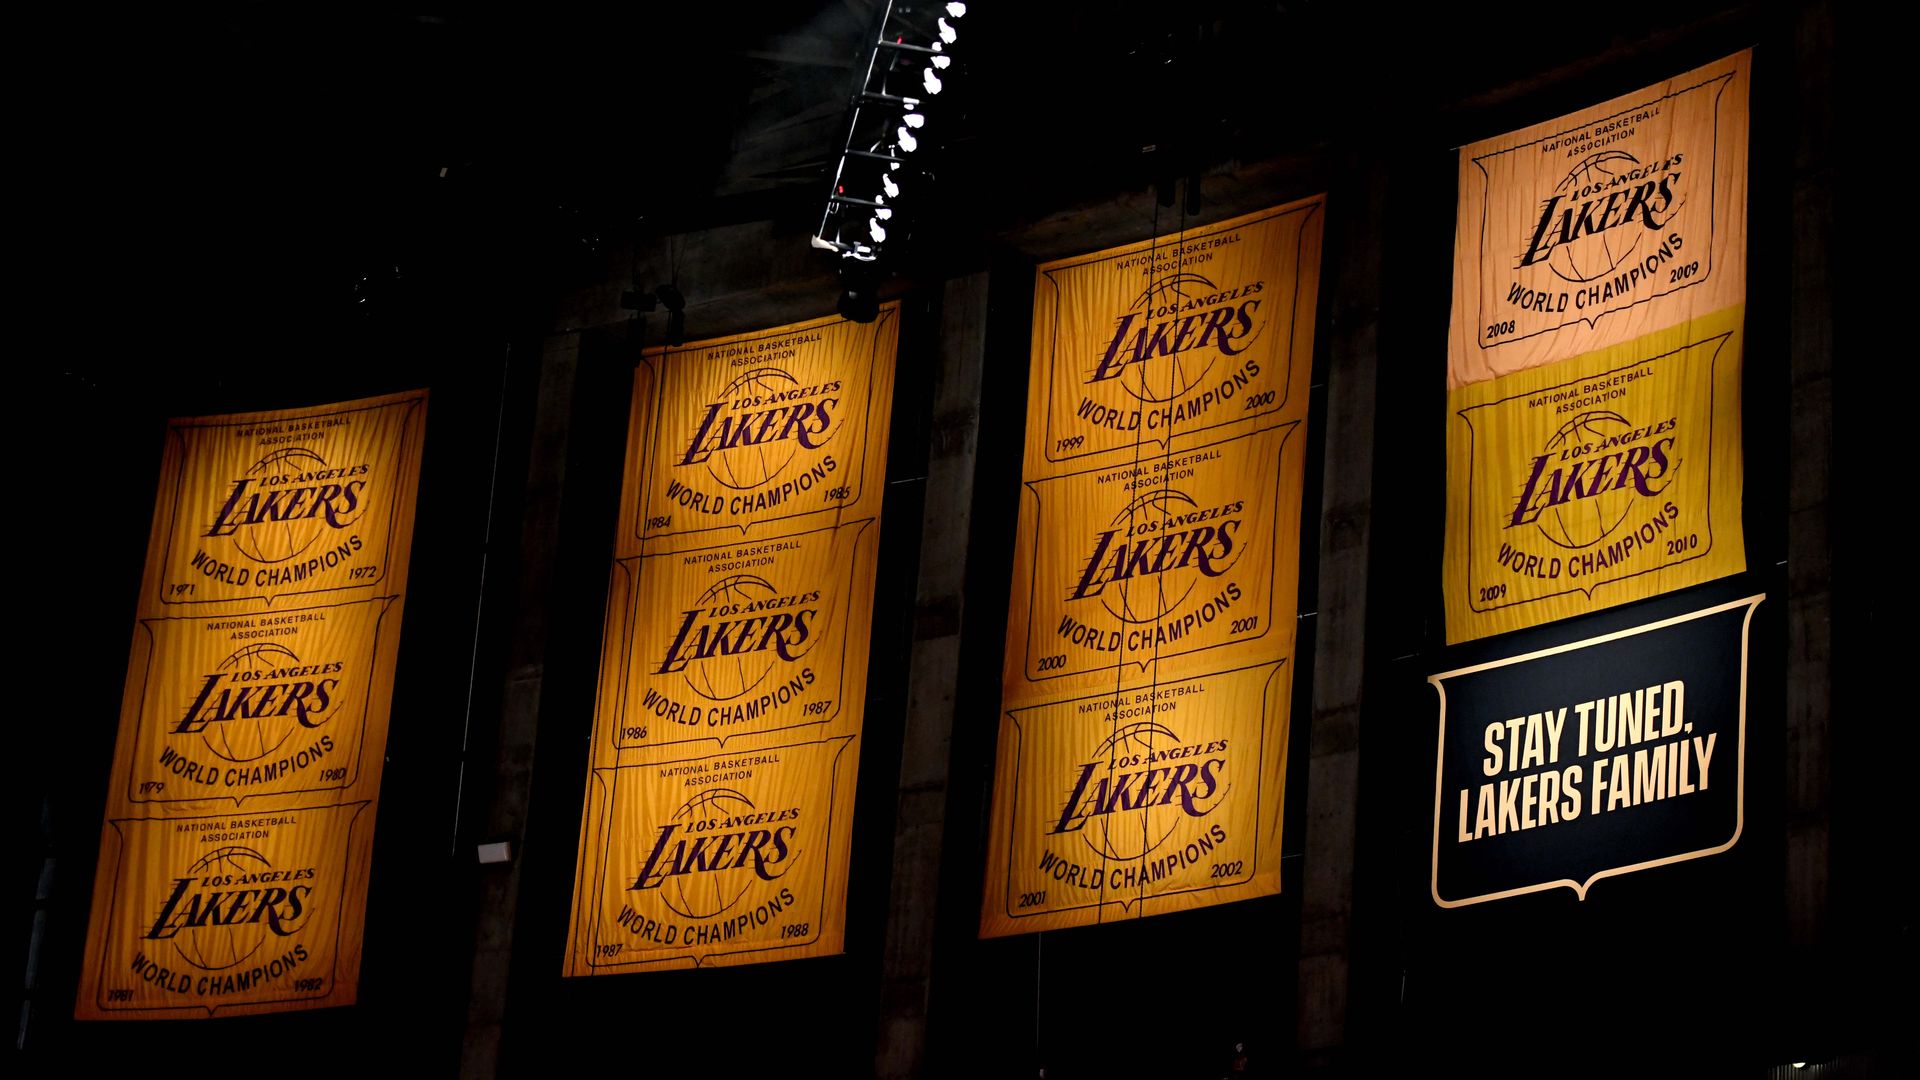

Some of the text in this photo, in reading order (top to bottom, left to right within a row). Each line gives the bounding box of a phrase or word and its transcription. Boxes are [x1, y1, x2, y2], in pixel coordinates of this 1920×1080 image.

[1542, 108, 1660, 152] NATIONAL BASKETBALL
[1567, 128, 1635, 157] ASSOCIATION
[1571, 154, 1683, 201] LOS ANGELES
[1513, 172, 1681, 270] LAKERS
[1117, 234, 1240, 270] NATIONAL BASKETBALL
[1143, 253, 1213, 276] ASSOCIATION
[1507, 233, 1682, 312] WORLD CHAMPIONS
[1670, 262, 1698, 283] 2009
[1147, 281, 1264, 319] LOS ANGELES
[1487, 320, 1515, 338] 2008
[707, 334, 822, 360] NATIONAL BASKETBALL
[1084, 300, 1261, 384] LAKERS
[730, 350, 796, 367] ASSOCIATION
[732, 381, 841, 410] LOS ANGELES
[1077, 360, 1260, 430] WORLD CHAMPIONS
[1529, 367, 1653, 408] NATIONAL BASKETBALL
[1245, 391, 1275, 410] 2000
[1556, 388, 1626, 414] ASSOCIATION
[237, 418, 351, 437] NATIONAL BASKETBALL
[260, 432, 324, 445] ASSOCIATION
[674, 399, 839, 467] LAKERS
[1561, 417, 1677, 461] LOS ANGELES
[1056, 436, 1084, 452] 1999
[260, 464, 369, 487] LOS ANGELES
[1097, 450, 1221, 484] NATIONAL BASKETBALL
[1123, 468, 1194, 491] ASSOCIATION
[666, 456, 836, 515] WORLD CHAMPIONS
[824, 487, 850, 502] 1985
[1503, 437, 1675, 529] LAKERS
[200, 480, 366, 538] LAKERS
[1127, 501, 1244, 537] LOS ANGELES
[647, 517, 671, 530] 1984
[1497, 501, 1679, 579] WORLD CHAMPIONS
[1667, 534, 1697, 555] 2010
[191, 535, 362, 586] WORLD CHAMPIONS
[684, 541, 800, 565] NATIONAL BASKETBALL
[709, 557, 774, 573] ASSOCIATION
[1064, 520, 1241, 601] LAKERS
[349, 566, 376, 579] 1972
[170, 584, 195, 596] 1971
[1480, 584, 1507, 601] 2009
[709, 591, 820, 617] LOS ANGELES
[207, 613, 325, 631] NATIONAL BASKETBALL
[1057, 583, 1242, 652] WORLD CHAMPIONS
[1230, 616, 1257, 634] 2001
[230, 627, 298, 640] ASSOCIATION
[650, 609, 817, 674] LAKERS
[231, 662, 343, 682] LOS ANGELES
[1038, 655, 1067, 671] 2000
[168, 674, 339, 734] LAKERS
[642, 668, 815, 726] WORLD CHAMPIONS
[803, 701, 831, 716] 1987
[1078, 684, 1205, 714] NATIONAL BASKETBALL
[1104, 701, 1177, 722] ASSOCIATION
[621, 727, 647, 739] 1986
[1482, 680, 1693, 777] STAY TUNED,
[159, 736, 334, 787] WORLD CHAMPIONS
[660, 754, 779, 778] NATIONAL BASKETBALL
[1109, 739, 1228, 769] LOS ANGELES
[320, 768, 346, 781] 1980
[685, 771, 752, 786] ASSOCIATION
[140, 782, 164, 794] 1979
[1046, 759, 1225, 835] LAKERS
[1458, 732, 1717, 843] LAKERS FAMILY
[177, 815, 296, 832] NATIONAL BASKETBALL
[686, 808, 800, 833] LOS ANGELES
[200, 830, 269, 843] ASSOCIATION
[626, 824, 796, 891] LAKERS
[1039, 825, 1226, 890] WORLD CHAMPIONS
[1211, 861, 1243, 878] 2002
[201, 868, 315, 887] LOS ANGELES
[139, 878, 312, 939] LAKERS
[1020, 891, 1046, 907] 2001
[617, 888, 794, 945] WORLD CHAMPIONS
[781, 924, 808, 938] 1988
[596, 944, 622, 957] 1987
[131, 944, 308, 995] WORLD CHAMPIONS
[108, 990, 133, 1002] 1981
[295, 978, 322, 992] 1982
